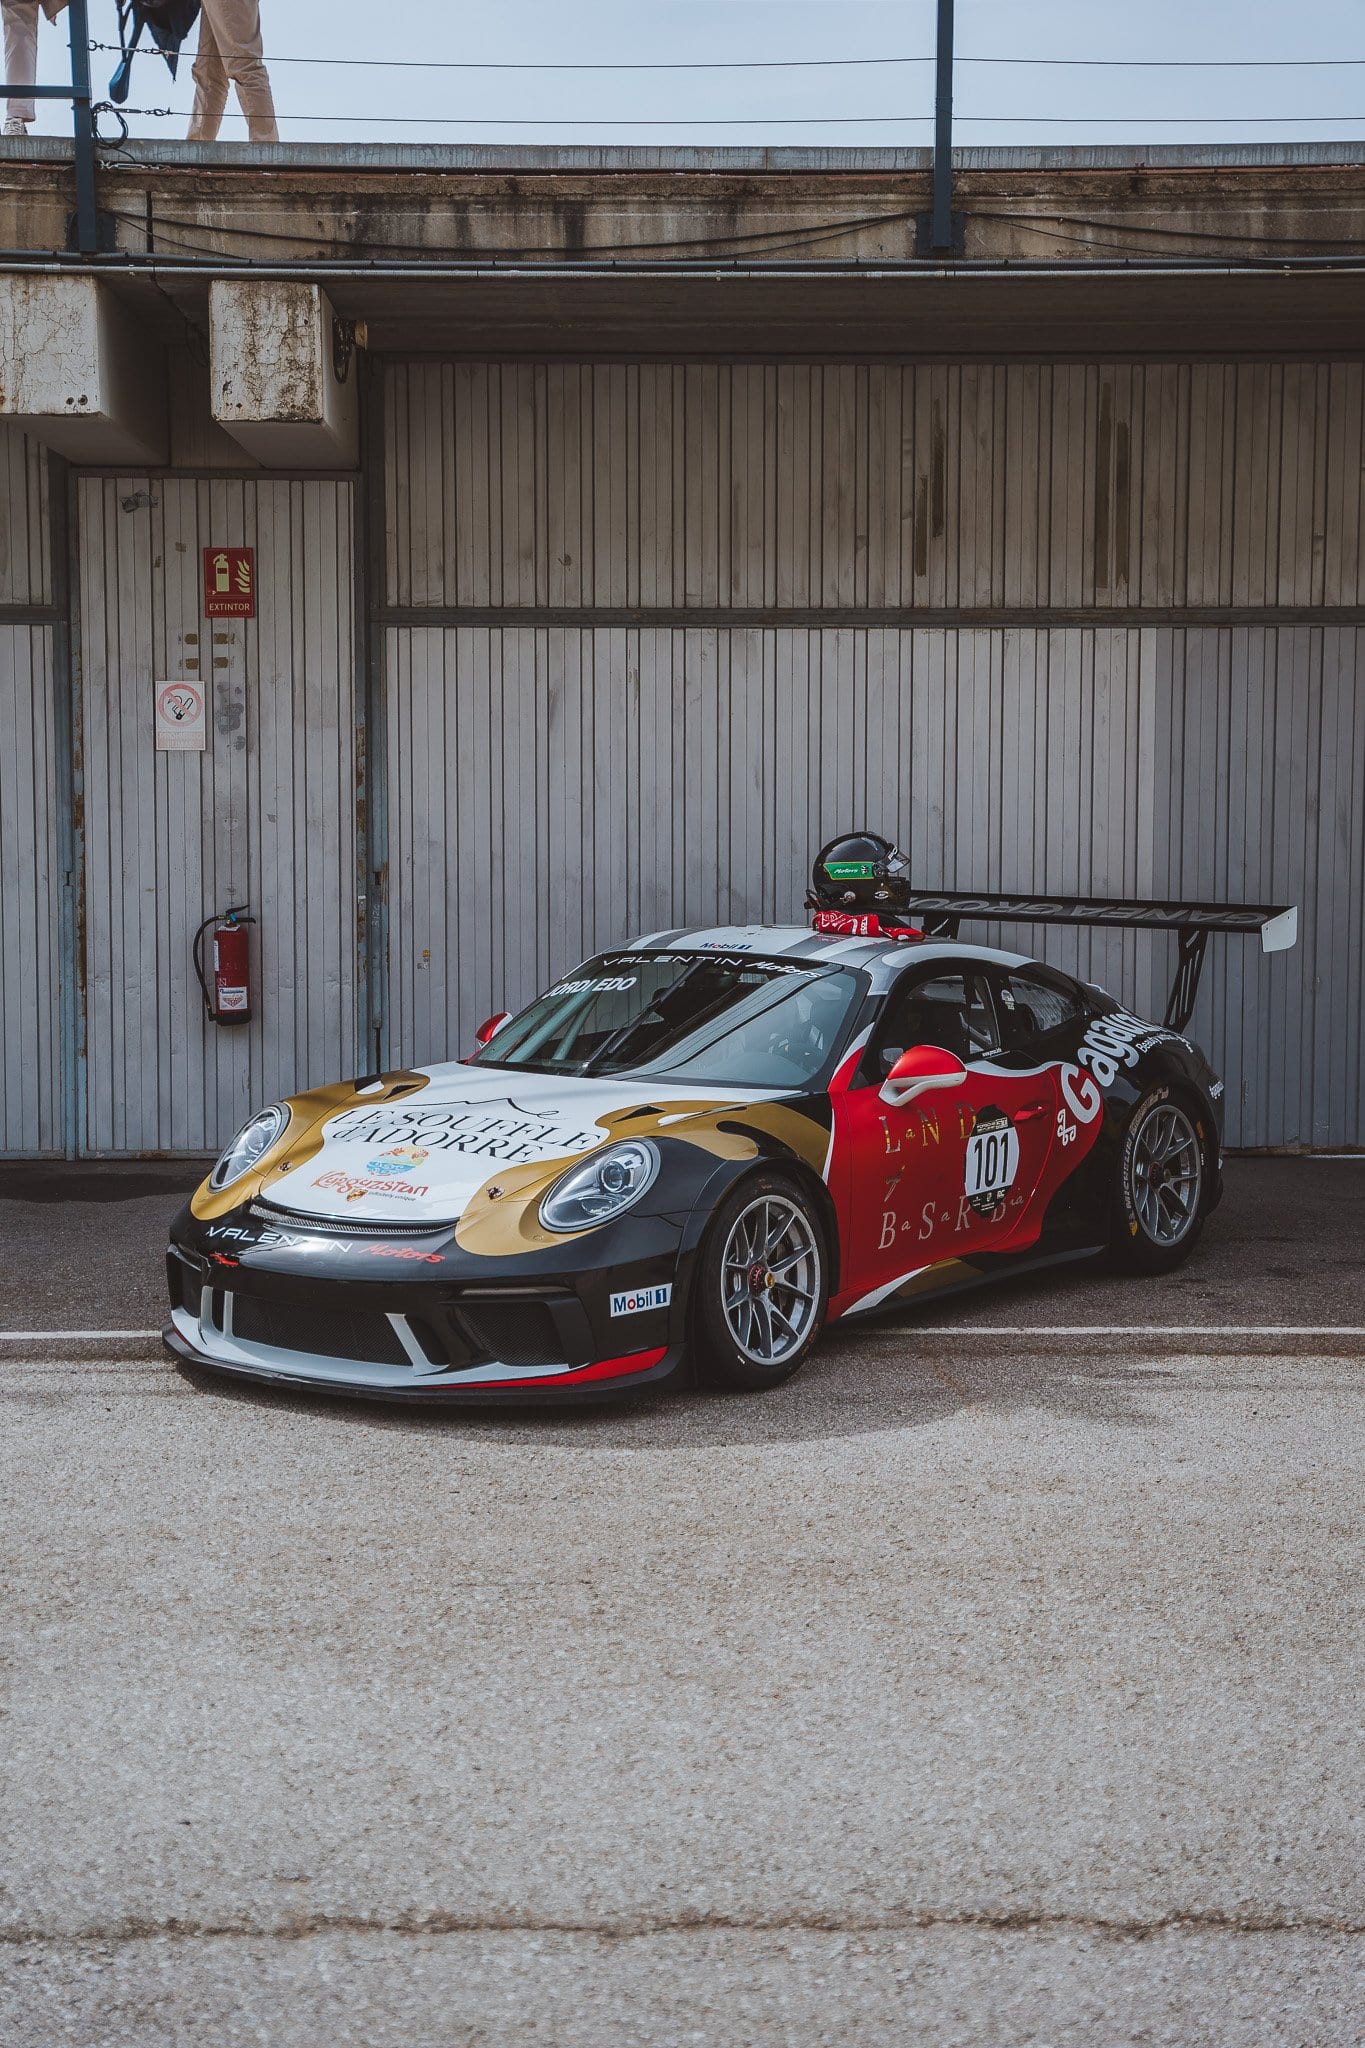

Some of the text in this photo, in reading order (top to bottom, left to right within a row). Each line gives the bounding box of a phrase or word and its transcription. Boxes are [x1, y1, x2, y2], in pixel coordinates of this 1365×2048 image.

[209, 603, 250, 611] EXTINTOR
[699, 943, 739, 951] Mobil
[603, 955, 822, 978] VALENTIN Motors
[592, 976, 637, 992] EDO
[331, 1110, 601, 1151] LE SOUFFLE
[973, 1132, 1009, 1190] 101
[360, 1244, 445, 1264] Motors
[613, 1290, 653, 1313] Mobil
